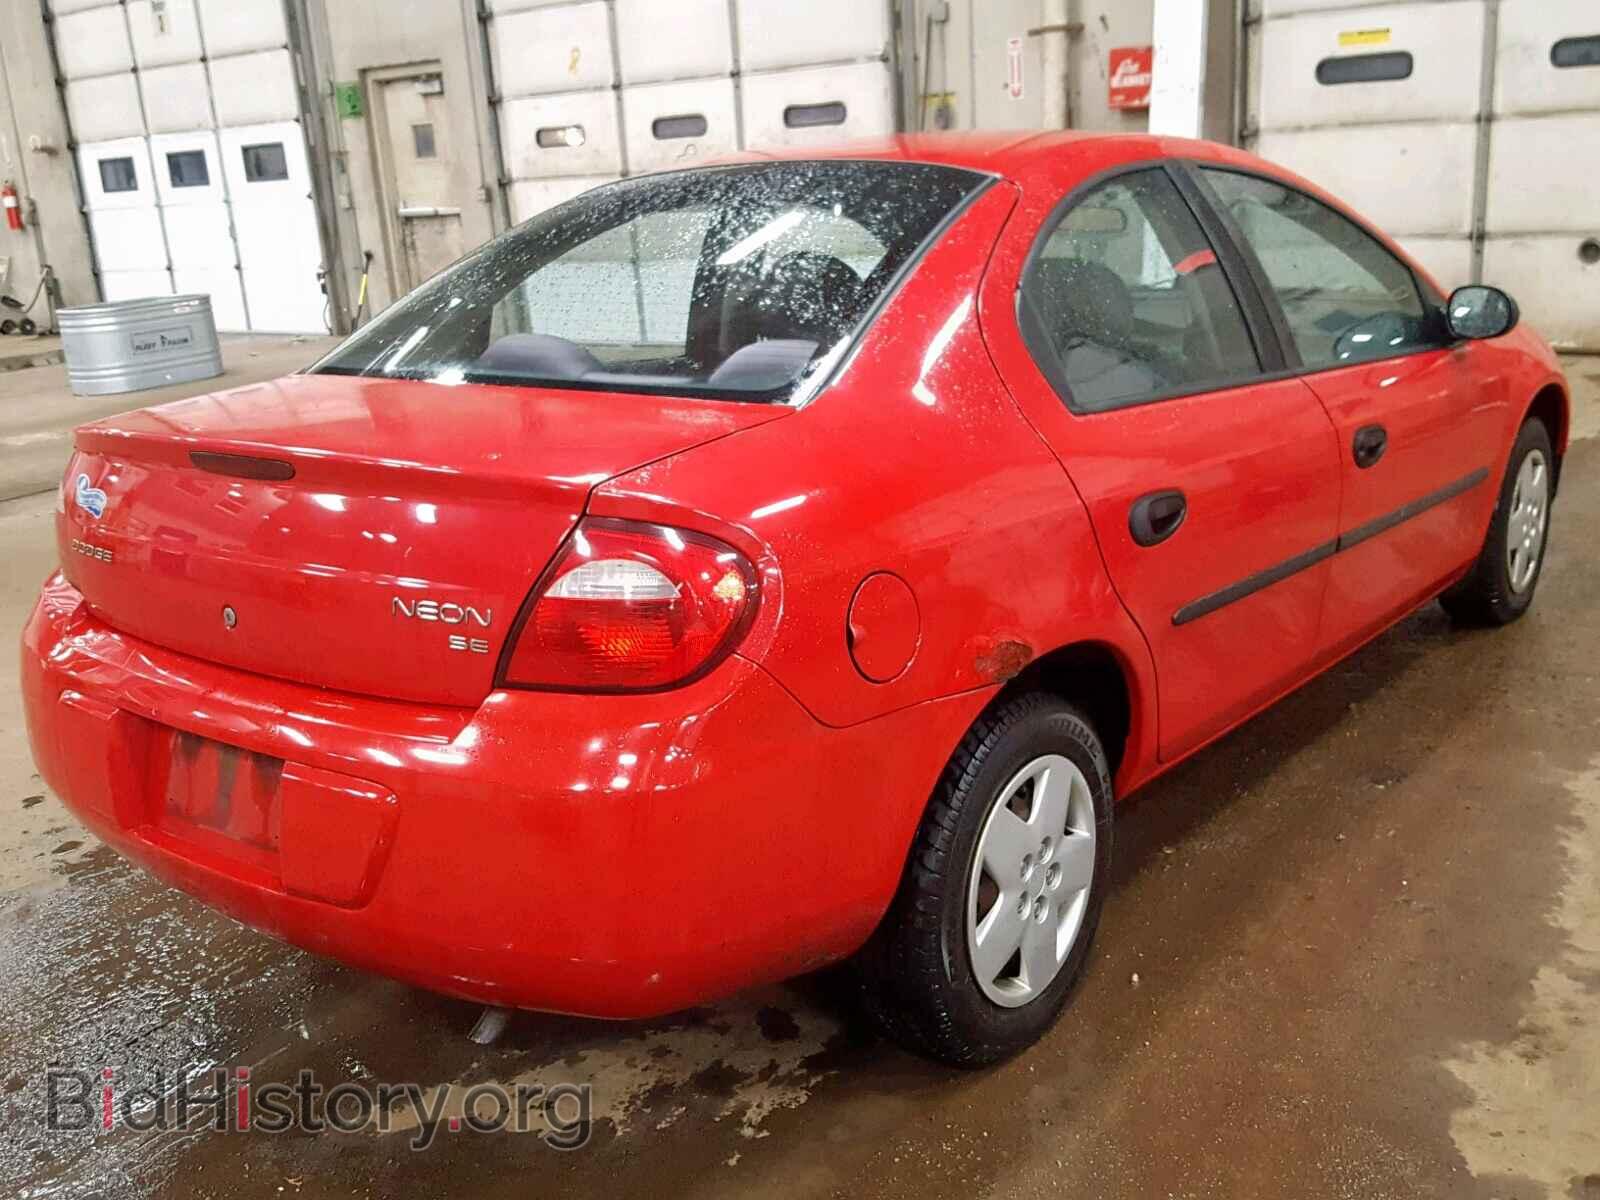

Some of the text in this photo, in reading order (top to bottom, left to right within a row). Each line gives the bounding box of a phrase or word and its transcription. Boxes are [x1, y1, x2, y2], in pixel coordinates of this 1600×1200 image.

[72, 538, 113, 563] DODGE
[392, 596, 492, 627] NEON
[447, 634, 490, 654] SE
